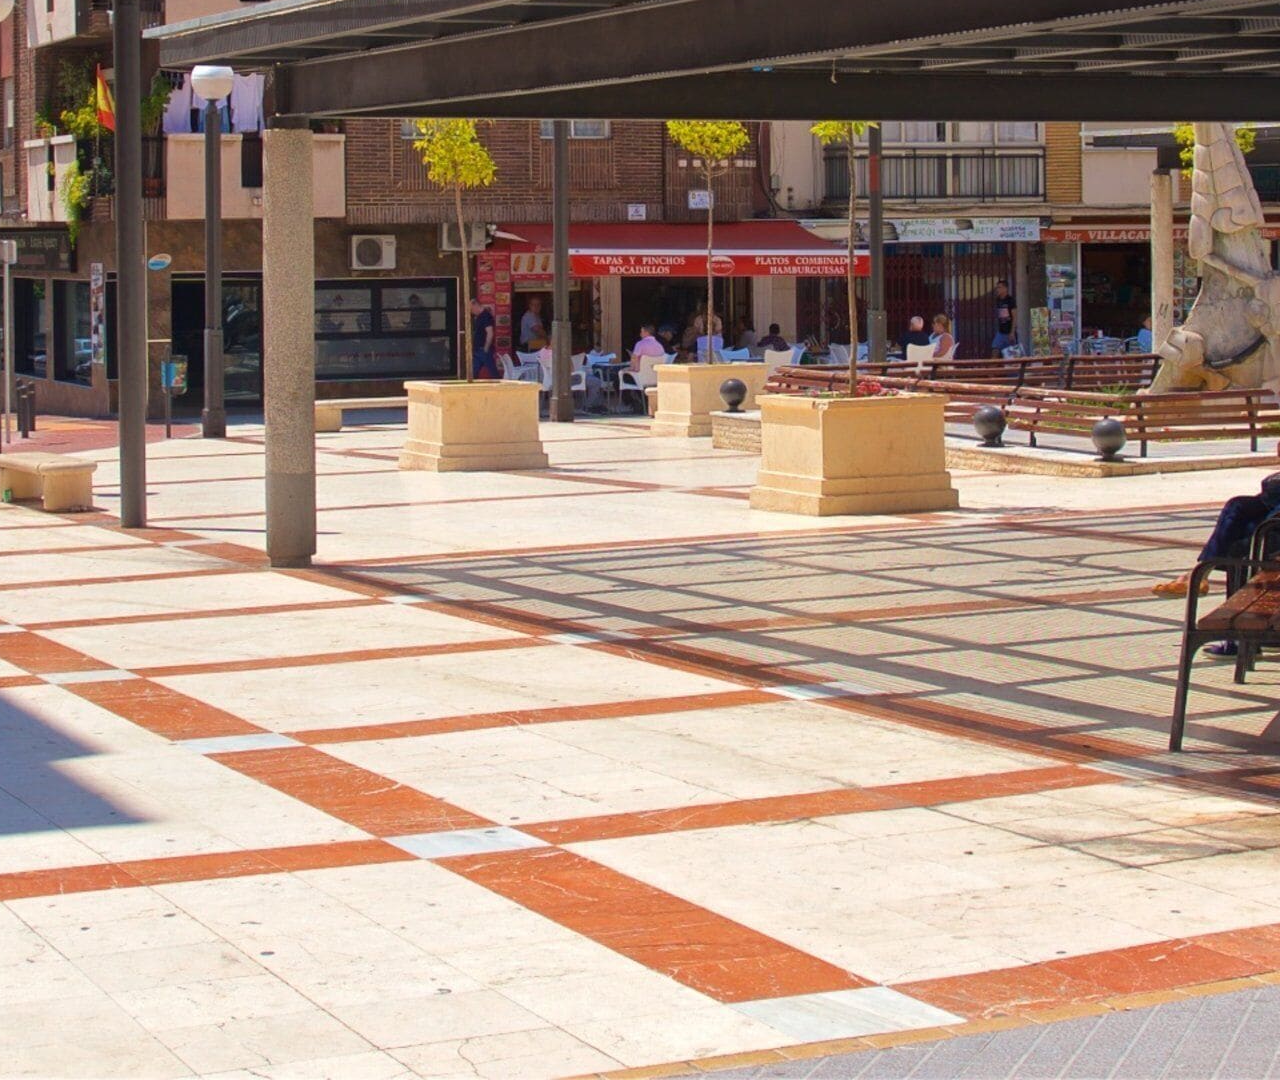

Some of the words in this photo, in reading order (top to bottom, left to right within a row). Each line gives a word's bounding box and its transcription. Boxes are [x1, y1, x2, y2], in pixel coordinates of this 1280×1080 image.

[1064, 231, 1082, 242] Bar
[593, 256, 623, 265] TAPAS
[629, 256, 637, 265] Y
[642, 256, 686, 265] PINCHOS
[755, 257, 789, 265] PLATOS
[795, 257, 858, 266] COMBINADS
[609, 265, 670, 274] BOCADILLOS
[770, 266, 845, 275] HAMBURGUESAS
